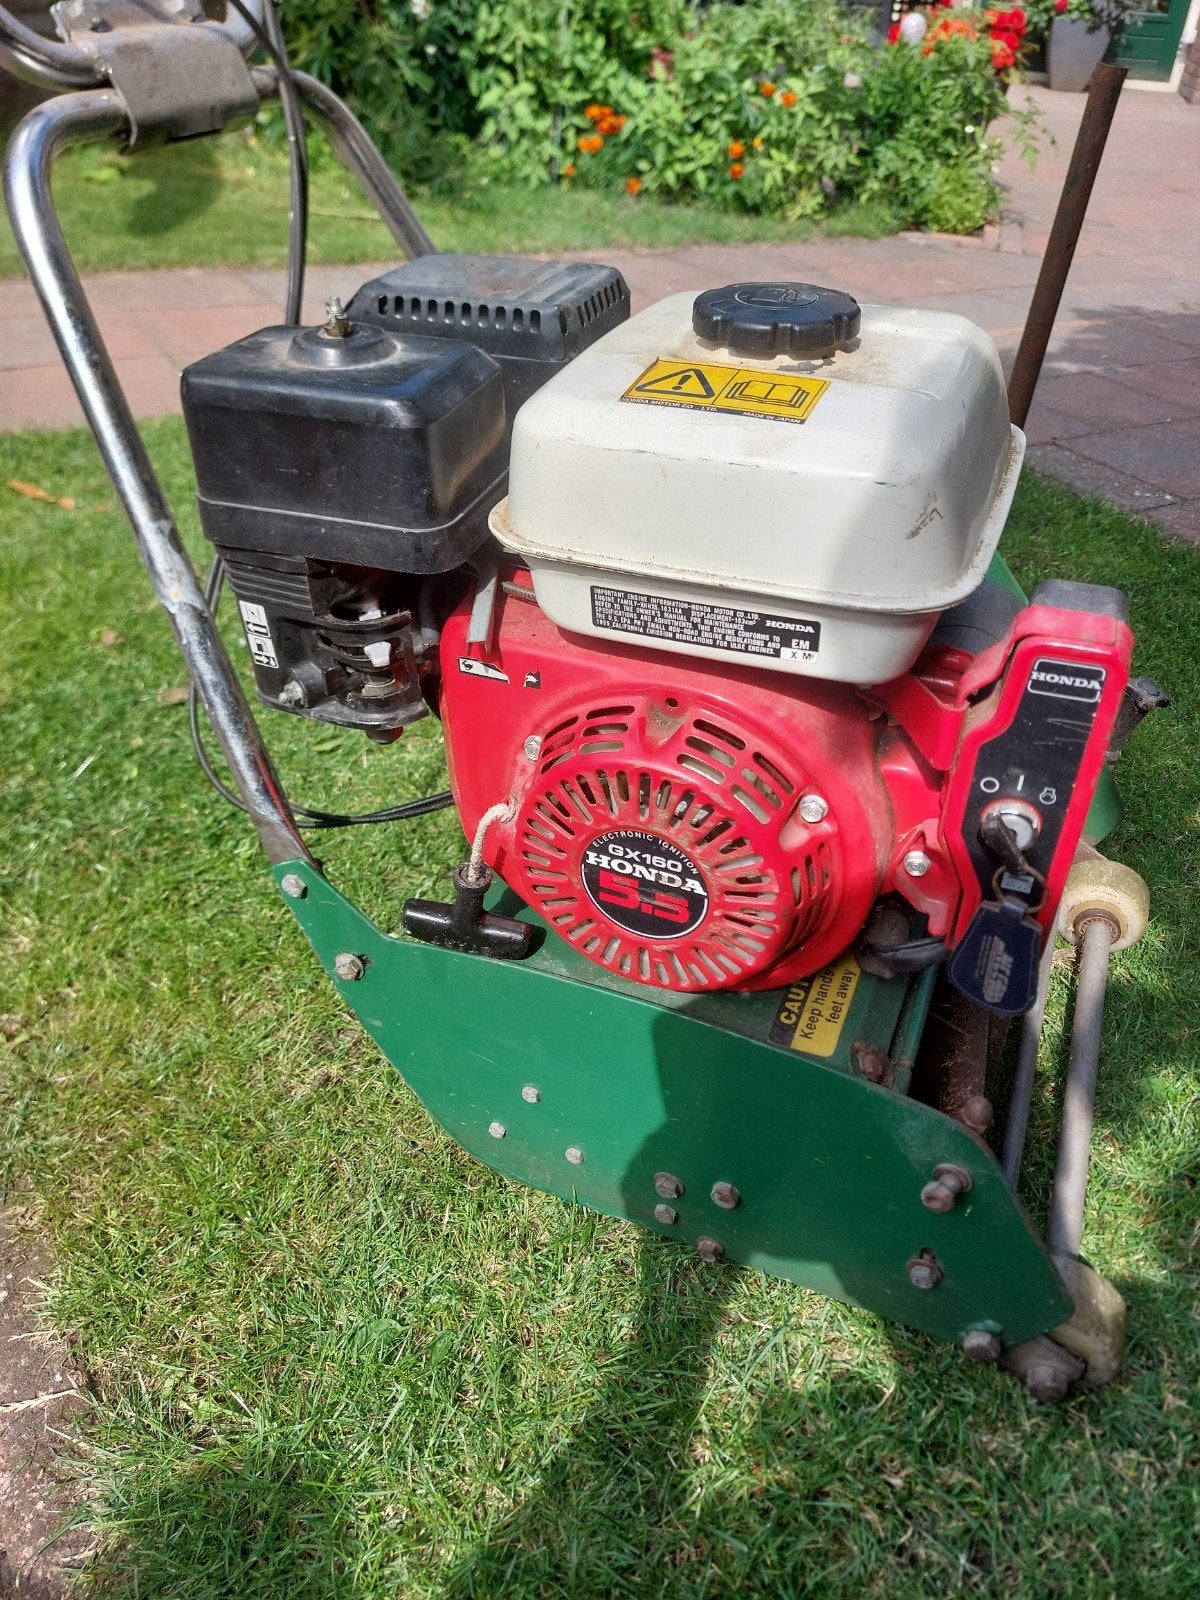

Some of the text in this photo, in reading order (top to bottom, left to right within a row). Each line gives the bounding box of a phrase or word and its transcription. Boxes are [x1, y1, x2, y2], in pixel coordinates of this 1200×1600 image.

[651, 400, 680, 408] MOTOR
[743, 411, 765, 419] MADE
[775, 416, 801, 424] JAPAN
[594, 594, 614, 602] ENGINE
[594, 588, 624, 598] IMPORTANT
[627, 593, 647, 601] ENGINE
[713, 607, 733, 615] MOTOR
[594, 600, 611, 608] REFER
[635, 607, 660, 616] OWNER'S
[663, 611, 686, 621] MANUAL
[704, 618, 744, 630] MAINTENANCE
[595, 606, 637, 619] SPECIFICATIONS
[697, 623, 710, 631] THIS
[713, 626, 735, 635] ENGINE
[738, 630, 769, 641] CONFORMS
[766, 620, 815, 633] HONDA
[596, 612, 605, 620] THE
[620, 616, 630, 624] EPA
[647, 621, 665, 630] SMALL
[668, 624, 698, 635] NON-ROAD
[701, 630, 722, 639] ENGINE
[725, 634, 764, 646] REGULATIONS
[767, 641, 780, 649] AND
[612, 621, 643, 632] CALIFORNIA
[646, 627, 672, 637] EMISSION
[675, 632, 712, 644] REGULATIONS
[791, 638, 810, 651] EM
[1030, 670, 1102, 691] HONDA
[592, 830, 700, 875] ELECTRONIC IGNITION
[608, 843, 683, 873] GX160
[585, 850, 708, 897] HONDA
[598, 870, 690, 924] 5.5
[799, 1006, 823, 1040] Keep
[811, 969, 836, 1006] hands
[825, 968, 857, 1024] feet away
